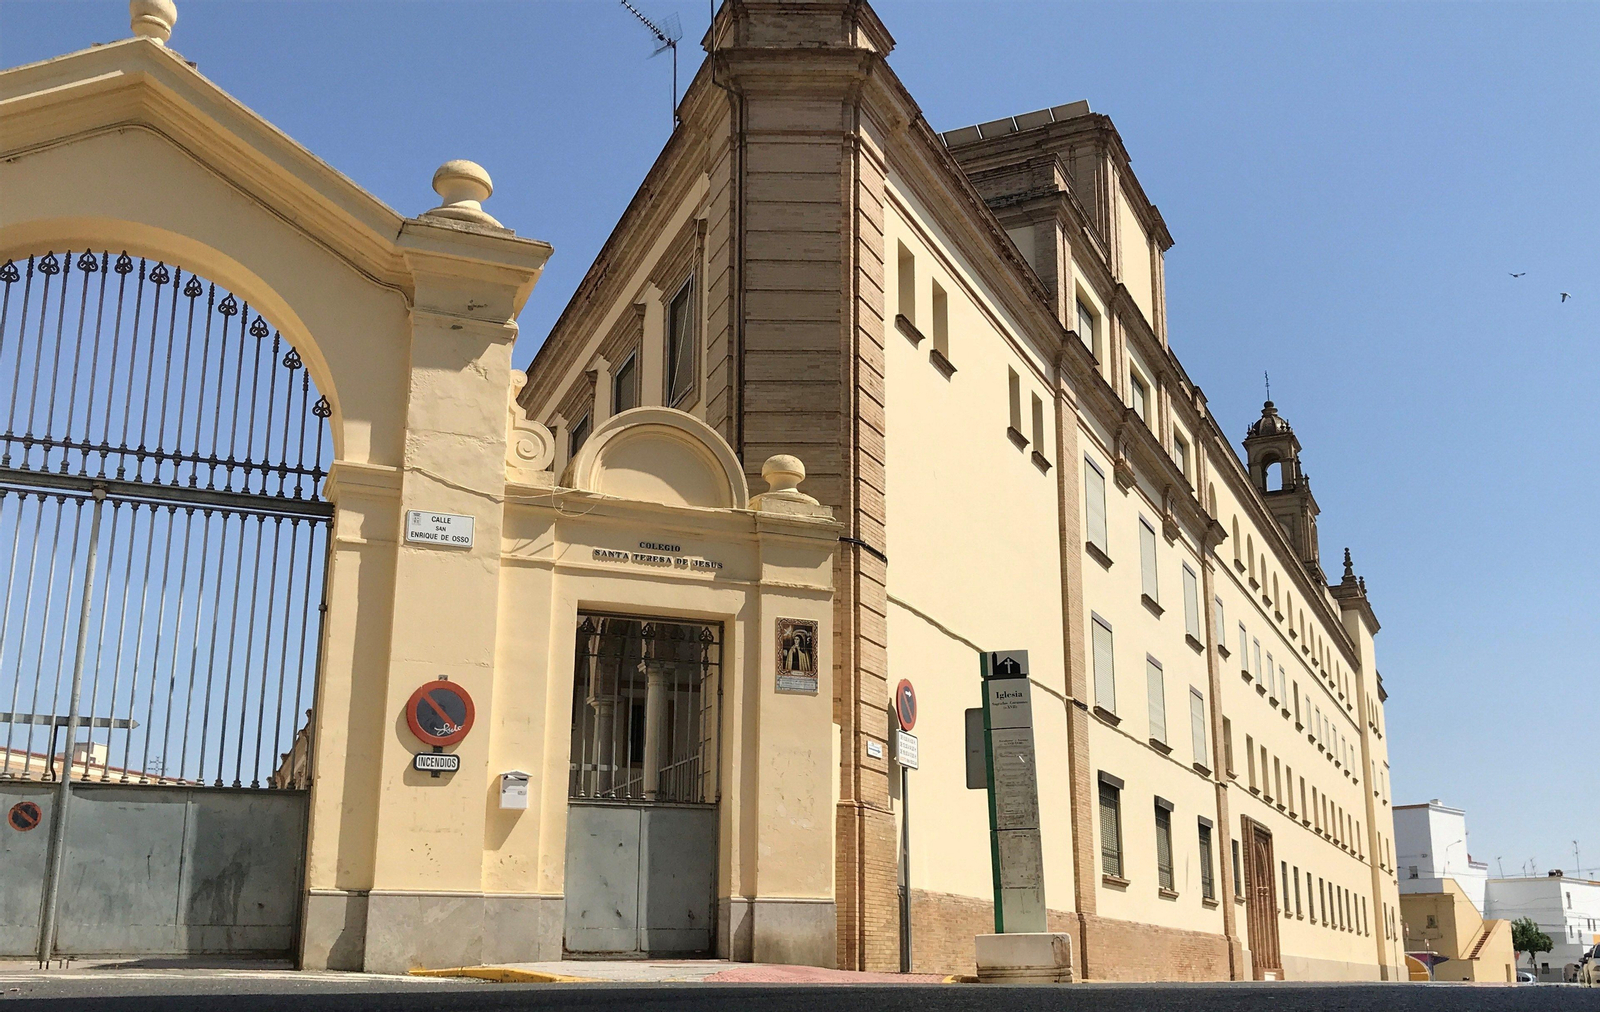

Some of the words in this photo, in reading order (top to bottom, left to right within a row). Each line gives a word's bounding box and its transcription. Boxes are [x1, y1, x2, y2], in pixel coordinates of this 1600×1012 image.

[431, 515, 452, 525] CALLE
[410, 531, 438, 540] ENRIQUE
[451, 535, 470, 544] OSSO
[639, 541, 681, 552] COLEGIO
[594, 549, 630, 559] SANTA
[633, 553, 673, 564] TERESA
[676, 558, 689, 566] DE
[995, 690, 1023, 700] Iglesia
[418, 757, 456, 768] INCENDIOS
